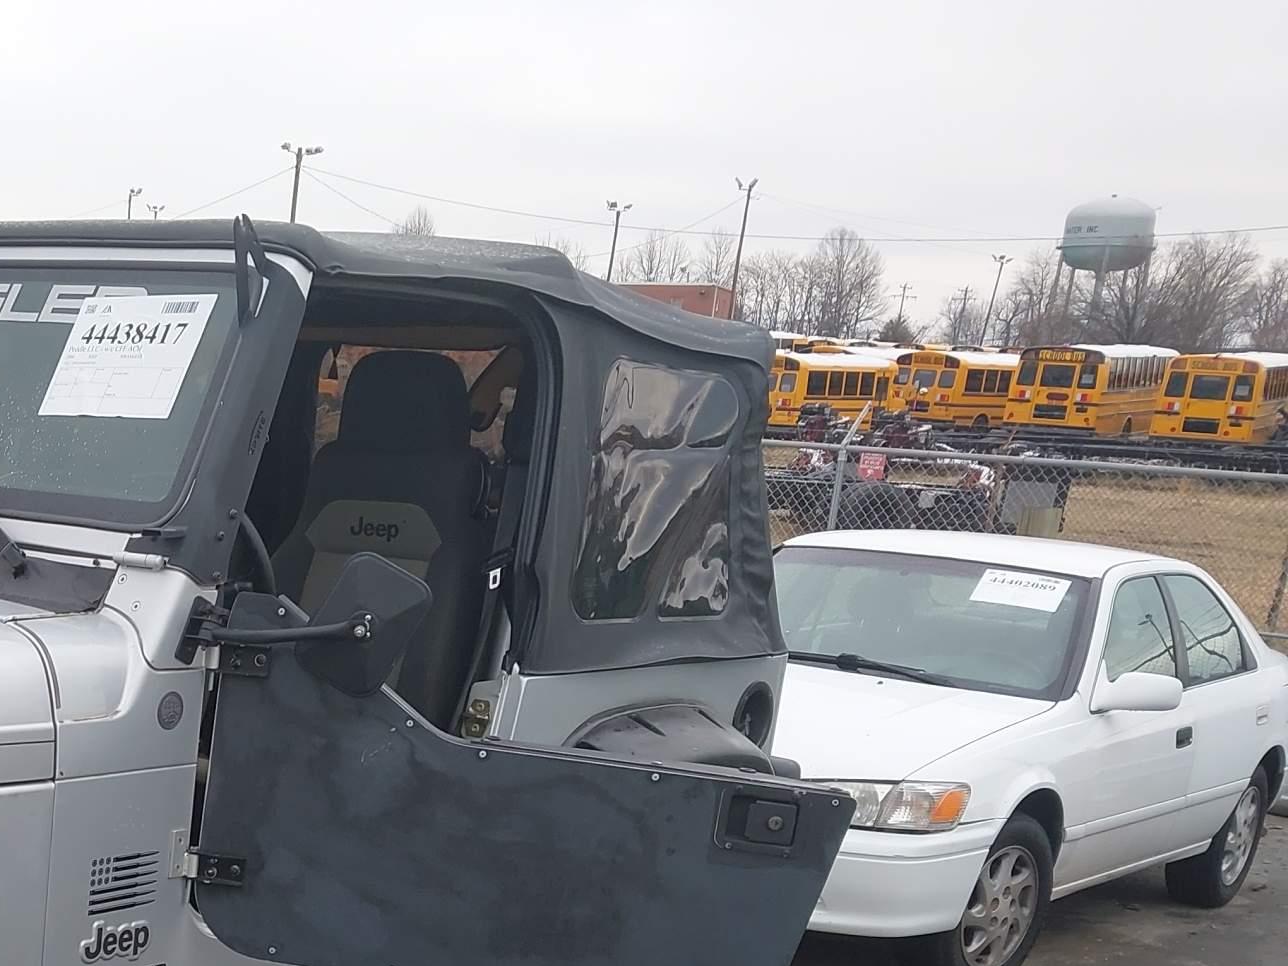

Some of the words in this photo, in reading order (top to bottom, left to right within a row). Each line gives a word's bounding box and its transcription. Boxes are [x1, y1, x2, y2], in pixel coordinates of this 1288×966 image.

[81, 322, 189, 345] 44438417
[350, 516, 399, 542] Jeep
[989, 577, 1057, 592] 44402089
[82, 923, 151, 962] Jeep
